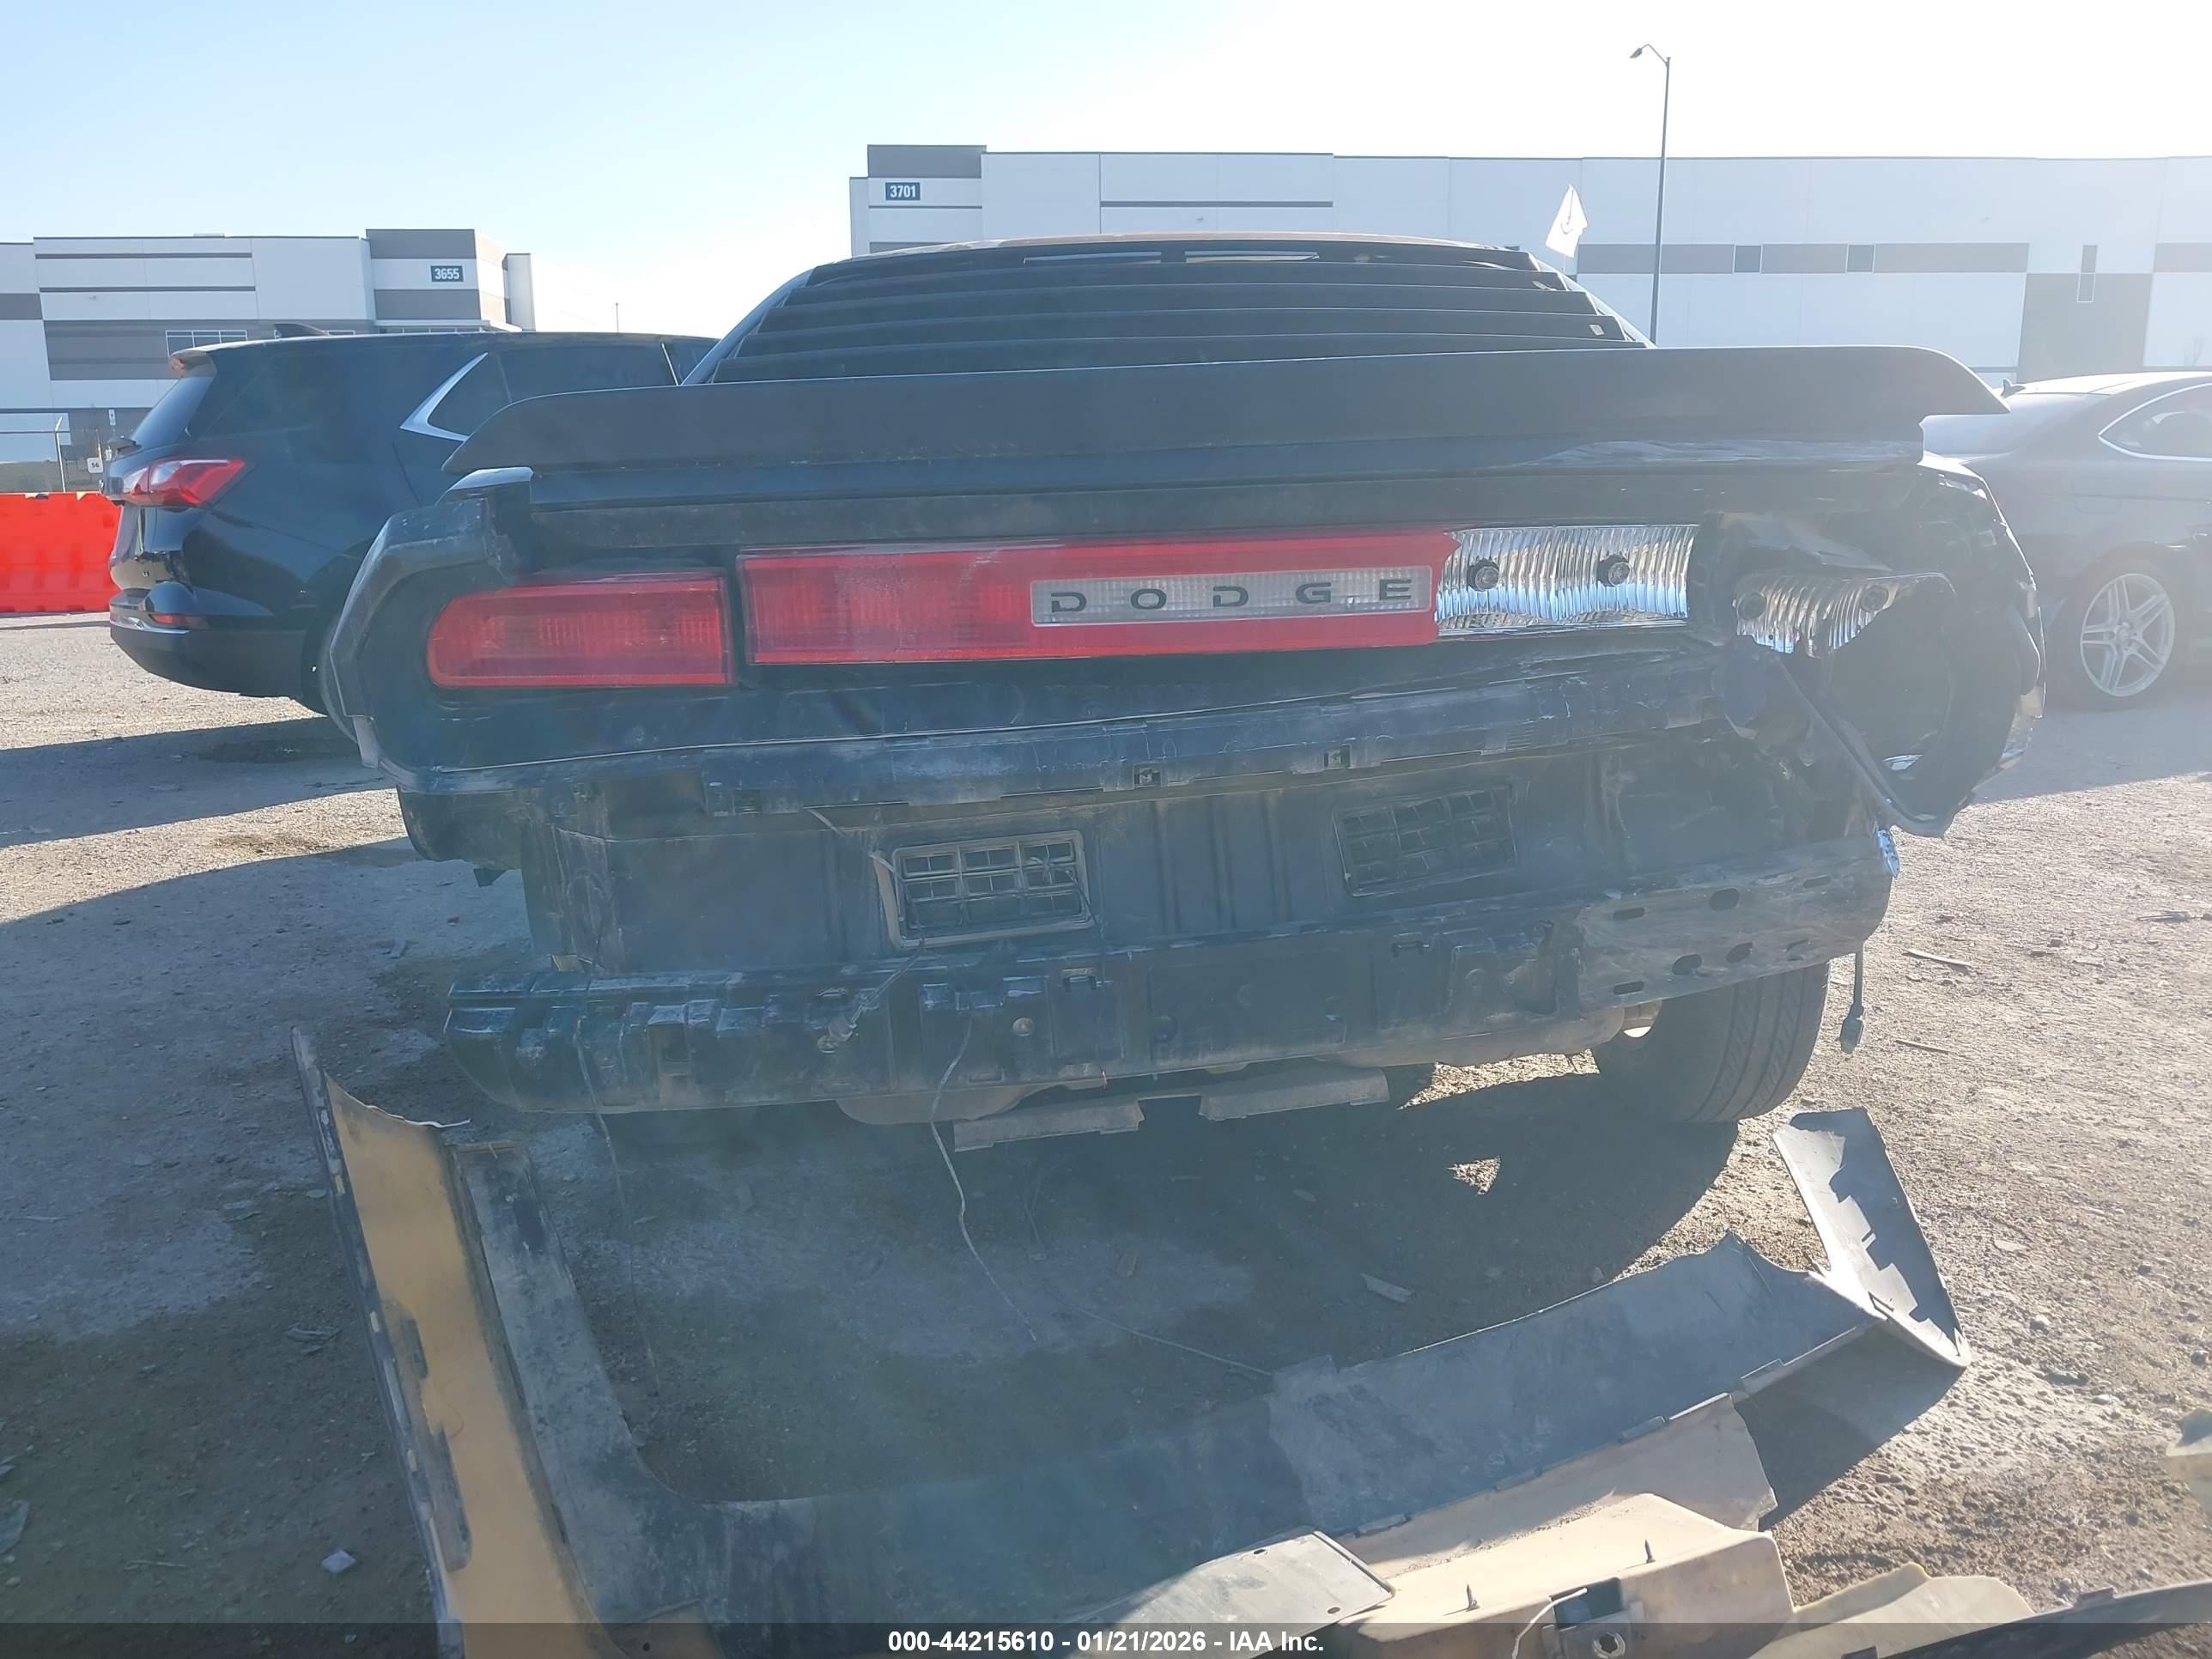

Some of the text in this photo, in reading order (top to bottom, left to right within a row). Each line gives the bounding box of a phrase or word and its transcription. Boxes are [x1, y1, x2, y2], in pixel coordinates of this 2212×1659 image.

[890, 185, 916, 198] 3701
[434, 268, 460, 280] 3655
[1049, 578, 1413, 613] DODGE
